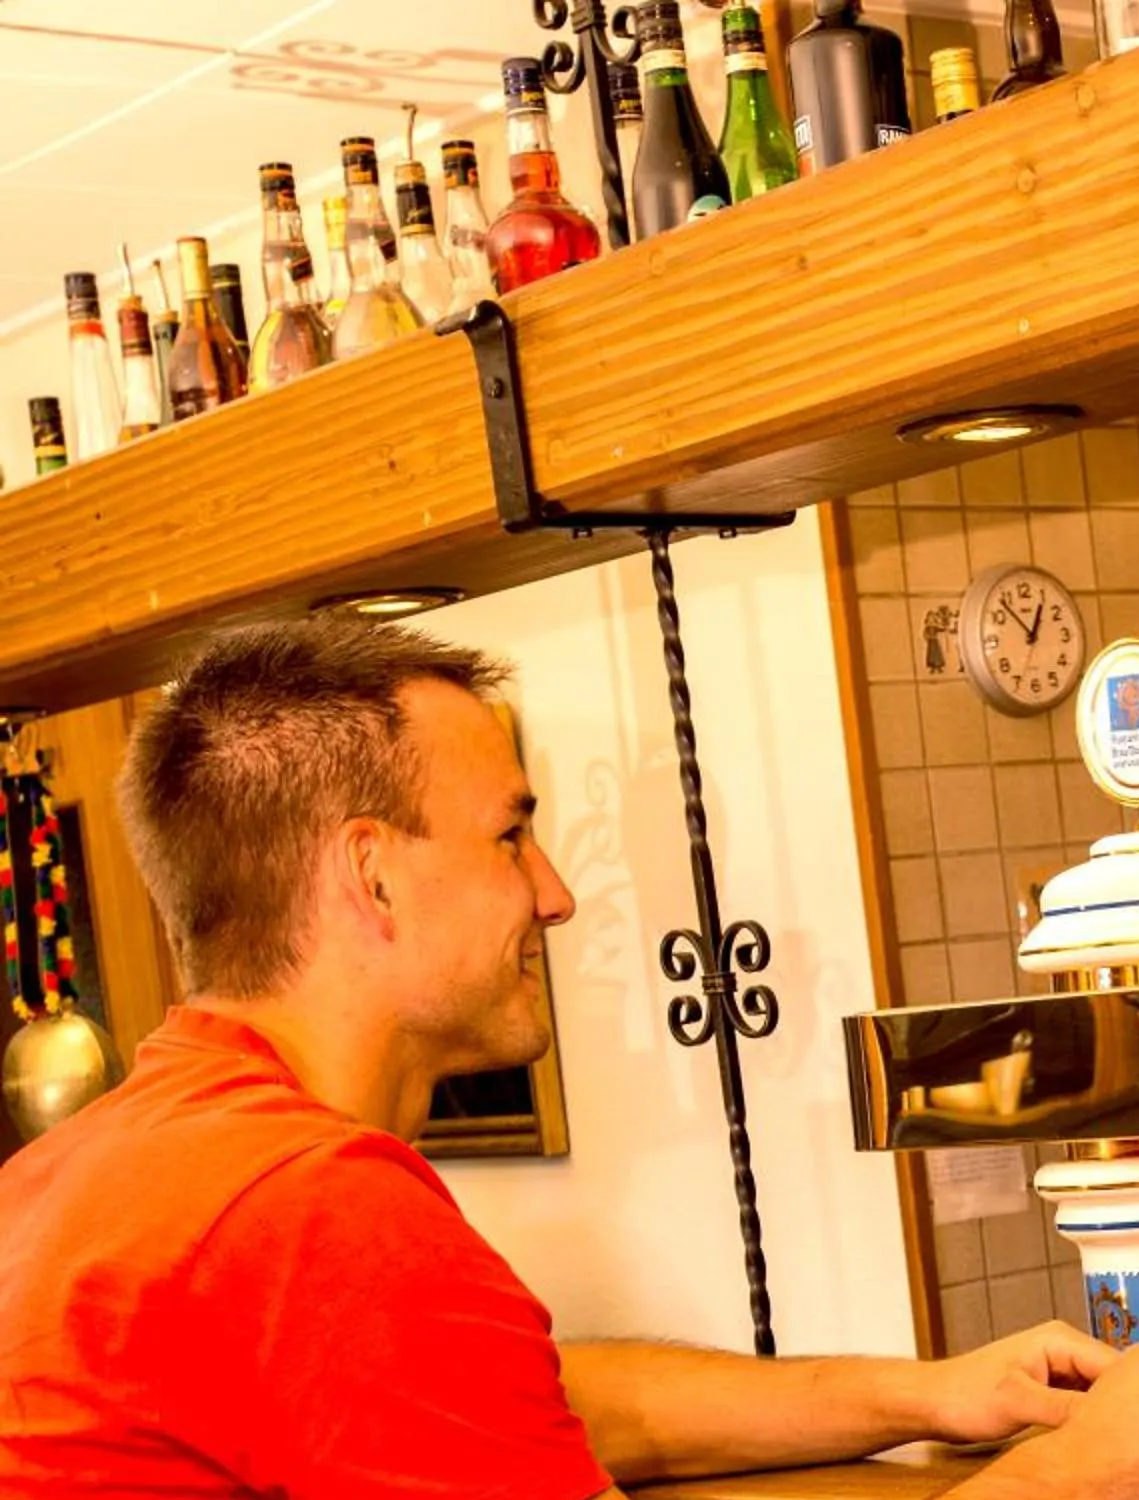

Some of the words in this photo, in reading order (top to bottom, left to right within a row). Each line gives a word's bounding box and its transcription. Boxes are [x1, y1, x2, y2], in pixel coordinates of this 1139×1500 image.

[1017, 582, 1031, 599] 12
[1040, 589, 1046, 603] 1
[1051, 605, 1062, 621] 2
[1060, 627, 1071, 643] 3
[999, 657, 1011, 673] 8
[1057, 653, 1068, 667] 4
[1012, 675, 1022, 692] 7
[1030, 678, 1042, 693] 6
[1048, 671, 1059, 687] 5
